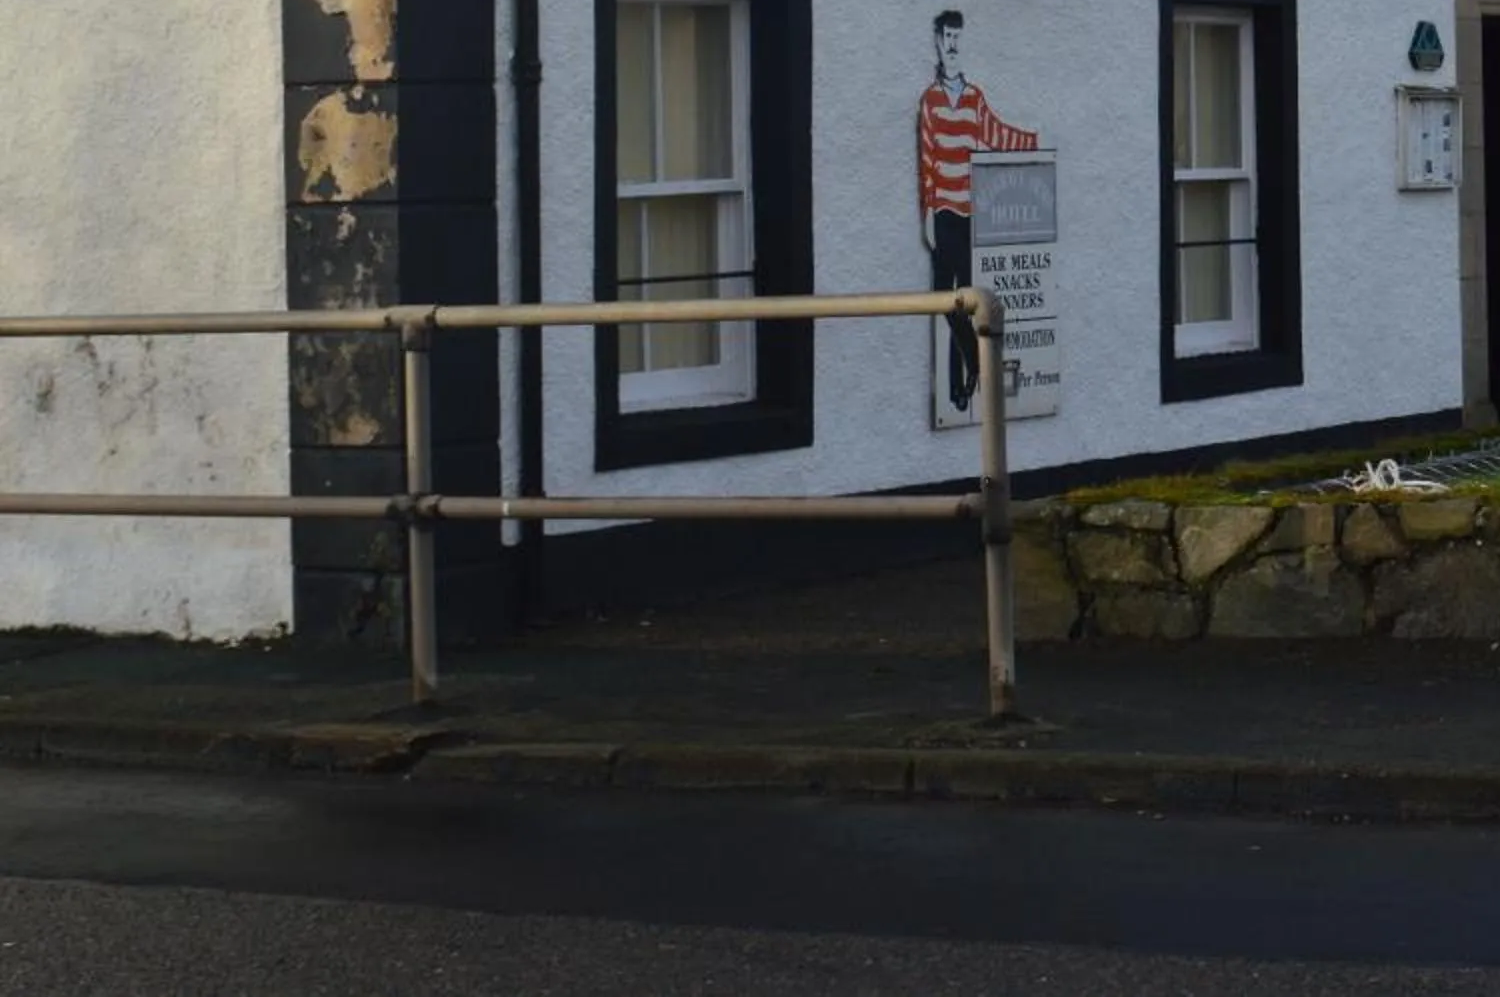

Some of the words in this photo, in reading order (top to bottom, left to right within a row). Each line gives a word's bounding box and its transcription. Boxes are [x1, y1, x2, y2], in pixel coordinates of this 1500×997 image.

[980, 255, 1007, 273] BAR
[1011, 252, 1052, 270] MEALS
[993, 273, 1041, 292] SNACKS
